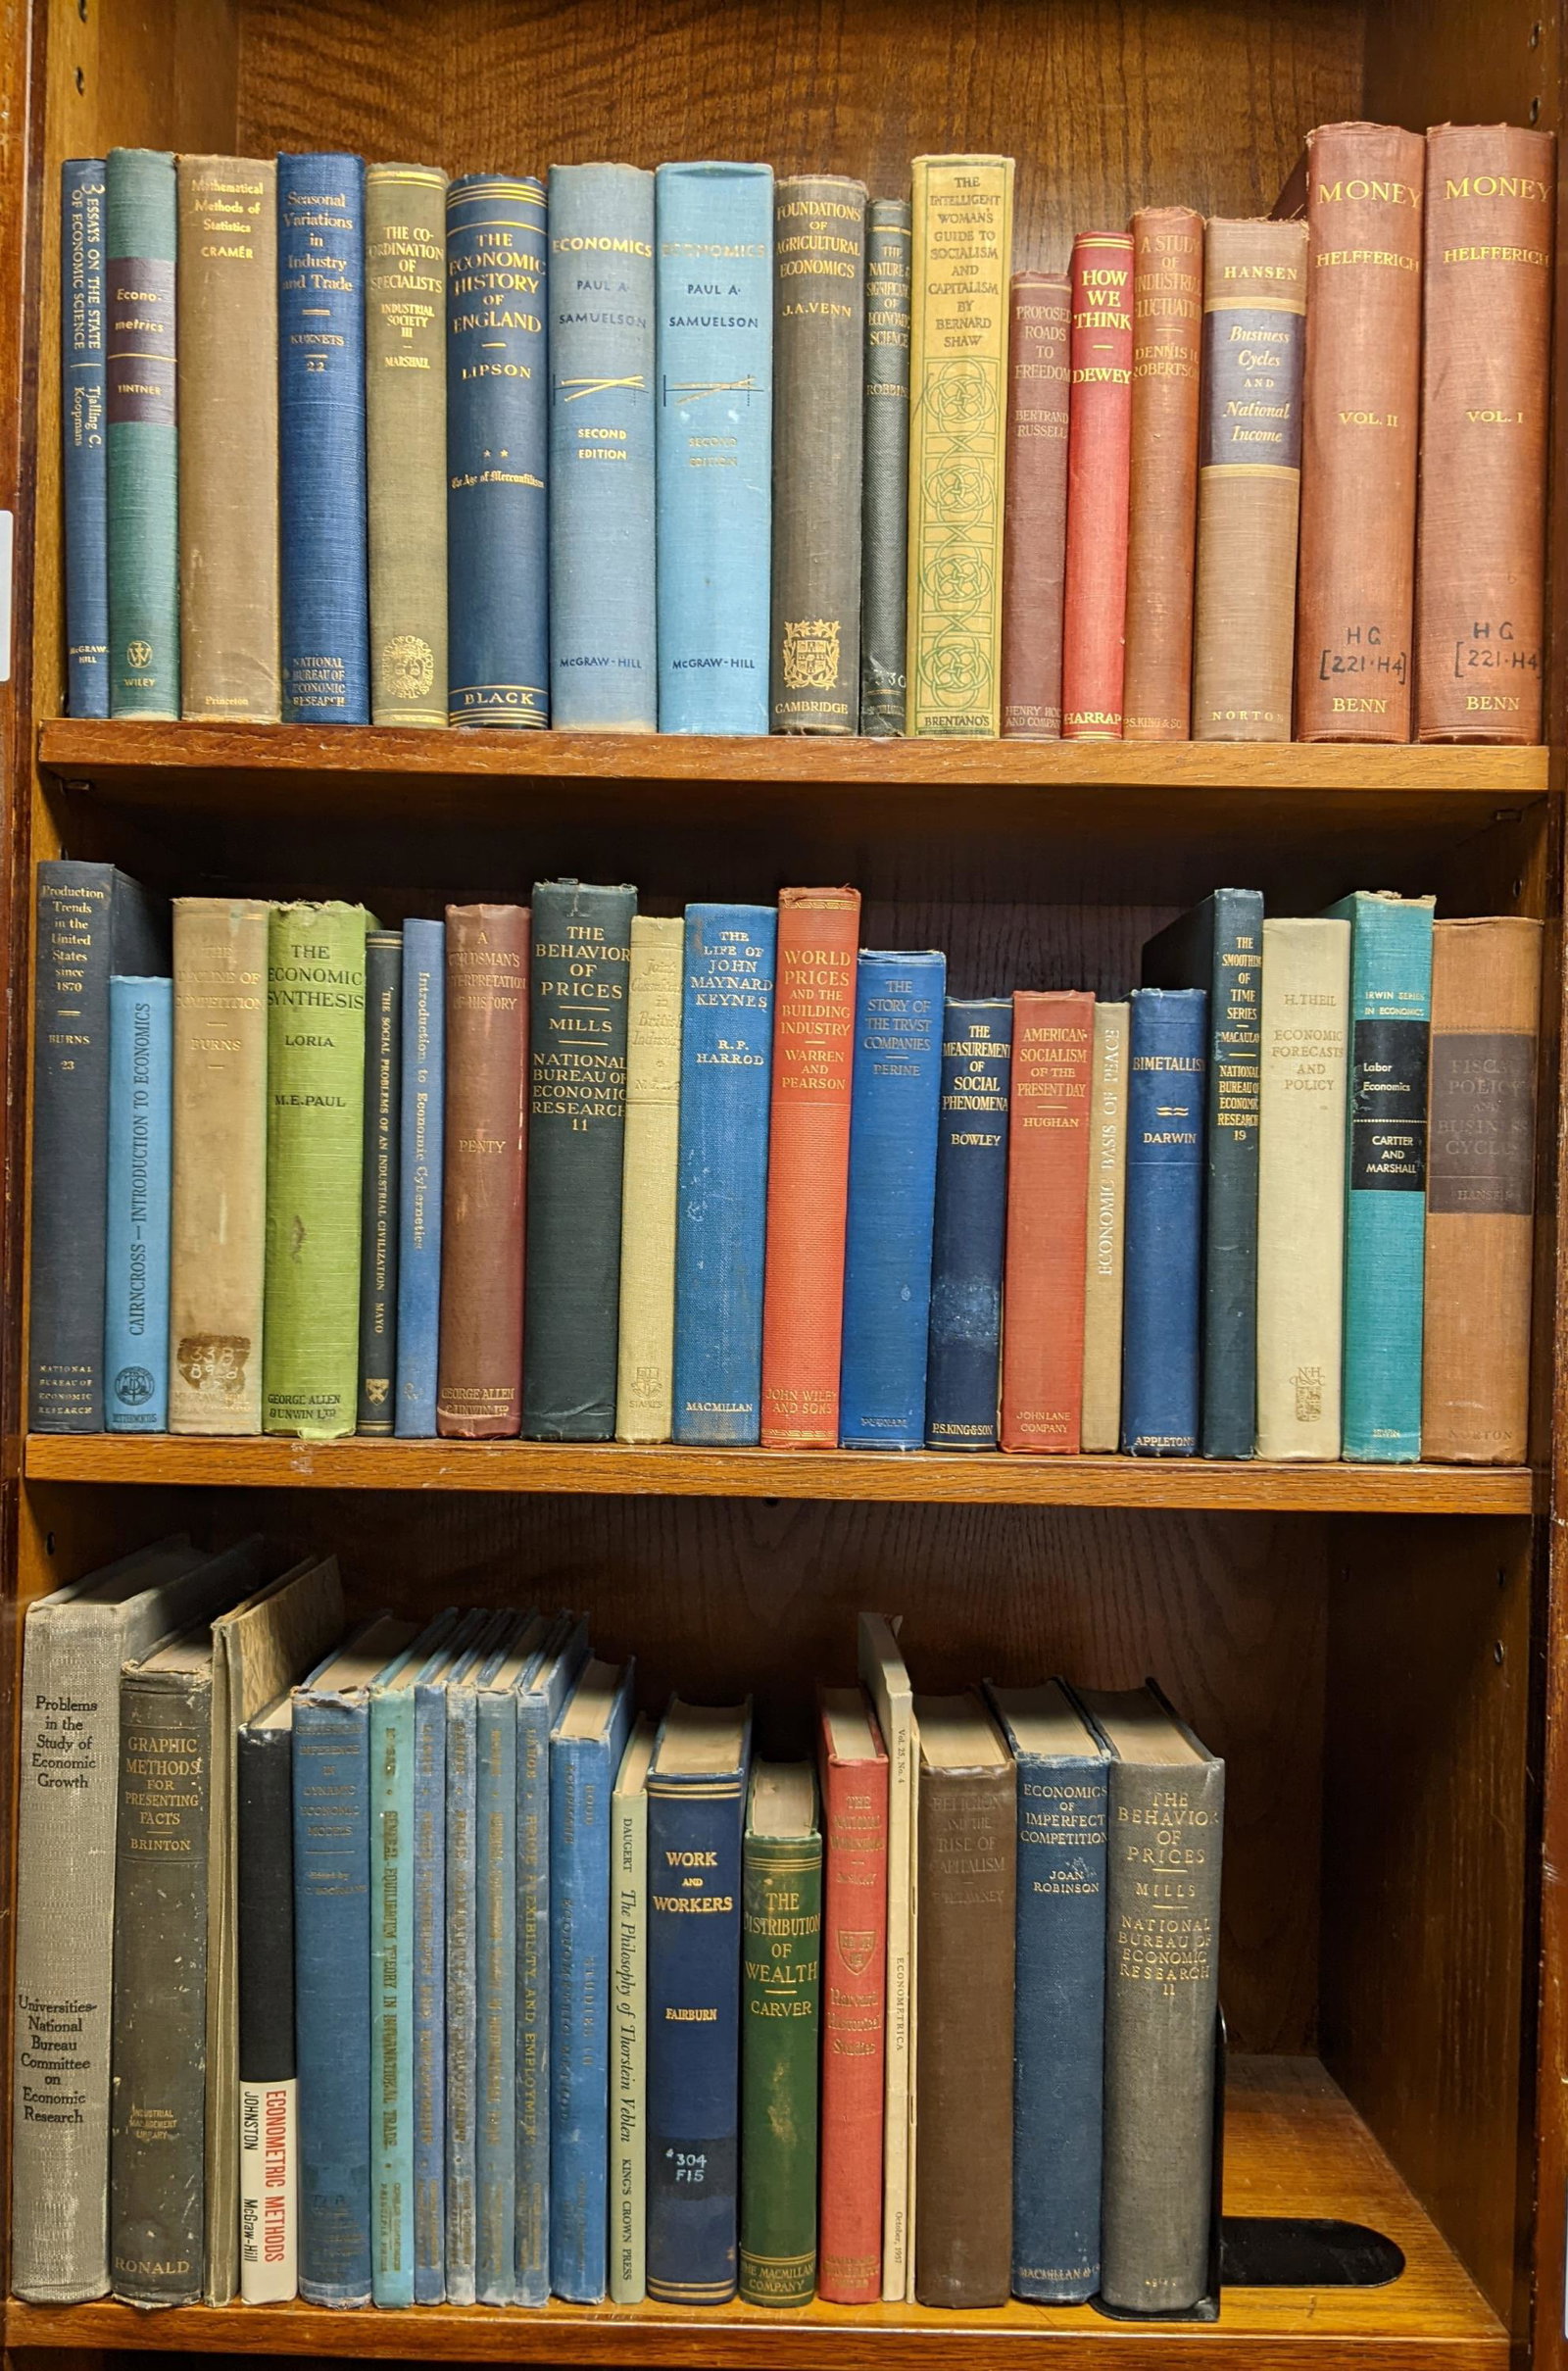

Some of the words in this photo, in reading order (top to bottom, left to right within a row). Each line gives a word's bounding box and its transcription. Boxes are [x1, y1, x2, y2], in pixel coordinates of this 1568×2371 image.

[82, 184, 105, 195] 3
[954, 176, 980, 189] THE
[1444, 175, 1552, 203] MONEY
[72, 189, 82, 208] OF
[1317, 179, 1421, 209] MONEY
[248, 199, 261, 215] of
[88, 199, 100, 243] ESSAYS
[204, 220, 251, 233] Statistics
[809, 222, 828, 230] OF
[309, 232, 323, 247] in
[476, 233, 513, 247] THE
[934, 231, 974, 242] GUIDE
[979, 231, 996, 241] TO
[73, 213, 83, 291] ECONOMIC
[553, 237, 653, 259] ECONOMICS
[930, 249, 999, 260] SOCIALISM
[88, 250, 99, 271] ON
[288, 255, 347, 272] Industry
[449, 252, 546, 276] ECONOMIC
[1315, 250, 1420, 273] HELFFERICH
[1443, 246, 1549, 269] HELFFERICH
[779, 260, 855, 278] ECONOMICS
[952, 266, 979, 276] AND
[1224, 266, 1298, 281] HANSEN
[454, 272, 539, 296] HISTORY
[577, 280, 611, 291] PAUL
[1082, 270, 1128, 286] HOW
[88, 276, 100, 304] THE
[687, 284, 721, 295] PAUL
[928, 282, 999, 295] CAPITALISM
[483, 294, 504, 306] OF
[956, 301, 973, 313] BY
[1088, 291, 1121, 308] WE
[74, 295, 83, 350] SCIENCE
[115, 321, 164, 332] metrics
[453, 311, 542, 334] ENGLAND
[560, 314, 647, 329] SAMUELSON
[668, 317, 759, 328] SAMUELSON
[936, 319, 992, 330] BERNARD
[1074, 313, 1132, 330] THINK
[88, 310, 100, 350] STATE
[1024, 326, 1066, 341] ROADS
[1230, 326, 1290, 343] Business
[944, 336, 981, 348] SHAW
[1036, 346, 1054, 359] TO
[1238, 349, 1281, 370] Cycles
[462, 364, 531, 380] LIPSON
[1073, 368, 1132, 384] DEWEY
[1244, 378, 1275, 387] AND
[1339, 412, 1383, 425] VOL.
[1387, 415, 1398, 427] II
[1466, 411, 1511, 423] VOL.
[1517, 412, 1524, 423] I
[577, 428, 627, 440] SECOND
[1232, 425, 1282, 443] Income
[578, 449, 627, 460] EDITION
[123, 678, 156, 688] WILEY
[464, 692, 534, 705] BLACK
[1332, 697, 1388, 713] BENN
[1465, 696, 1520, 712] BENN
[775, 702, 849, 715] CAMBRIDGE
[53, 902, 92, 914] Trends
[51, 934, 91, 946] United
[565, 926, 605, 941] THE
[53, 950, 88, 962] States
[291, 945, 330, 960] THE
[704, 946, 737, 957] LIFE
[746, 947, 764, 957] OF
[784, 950, 851, 966] WORLD
[55, 967, 84, 978] since
[569, 963, 598, 977] OF
[708, 961, 757, 973] JOHN
[268, 967, 363, 985] ECONOMIC
[785, 970, 850, 987] PRICES
[56, 981, 82, 993] 1870
[541, 982, 622, 999] PRICES
[268, 991, 365, 1011] SYNTHESIS
[695, 993, 767, 1008] KEYNES
[790, 990, 814, 1001] AND
[818, 990, 844, 1001] THE
[1230, 989, 1255, 1003] TIME
[782, 1006, 851, 1018] BUILDING
[867, 1000, 910, 1013] STORY
[912, 1001, 931, 1013] OF
[416, 971, 430, 1063] Introduction
[1227, 1009, 1257, 1021] SERIES
[548, 1018, 612, 1033] MILLS
[781, 1022, 851, 1036] INDUSTRY
[49, 1034, 90, 1045] BURNS
[284, 1036, 335, 1048] LORIA
[381, 1017, 392, 1054] SOCIAL
[134, 1002, 151, 1085] ECONOMICS
[863, 1036, 931, 1052] COMPANIES
[696, 1054, 764, 1065] HARROD
[1020, 1048, 1087, 1063] SOCIALISM
[1103, 1029, 1120, 1082] PEACE
[61, 1061, 75, 1070] 23
[969, 1061, 985, 1072] OF
[1030, 1067, 1048, 1077] OF
[1051, 1067, 1076, 1078] THE
[1363, 1062, 1393, 1073] Labor
[417, 1068, 427, 1082] to
[533, 1070, 607, 1084] BUREAU
[380, 1059, 390, 1113] PROBLEMS
[782, 1077, 846, 1090] PEARSON
[954, 1077, 1001, 1092] SOCIAL
[1284, 1080, 1335, 1091] POLICY
[1363, 1081, 1411, 1092] Economics
[134, 1089, 148, 1112] TO
[1104, 1092, 1117, 1115] OF
[416, 1092, 428, 1160] Economic
[1023, 1117, 1079, 1127] HUGHAN
[951, 1133, 1002, 1146] BOWLEY
[1143, 1133, 1197, 1144] DARWIN
[1233, 1130, 1247, 1141] 19
[1372, 1136, 1413, 1146] CARTTER
[459, 1139, 507, 1154] PENTY
[1101, 1125, 1116, 1169] BASIS
[131, 1119, 148, 1223] INTRODUCTION
[1365, 1163, 1417, 1174] MARSHALL
[376, 1220, 387, 1291] CIVILIZATION
[129, 1243, 146, 1337] CAIRNCROSS
[375, 1303, 385, 1334] MAYO
[686, 1402, 753, 1412] MACMILLAN
[35, 1696, 98, 1711] Problems
[45, 1716, 58, 1731] in
[63, 1717, 83, 1731] the
[36, 1735, 74, 1751] Study
[78, 1736, 93, 1750] of
[128, 1737, 197, 1754] GRAPHIC
[31, 1754, 96, 1769] Economic
[37, 1773, 89, 1788] Growth
[125, 1792, 199, 1806] PRESENTING
[1023, 1784, 1107, 1799] ECONOMICS
[1026, 1813, 1105, 1827] IMPERFECT
[130, 1839, 191, 1851] BRINTON
[622, 1818, 632, 1873] DAUGERT
[665, 1852, 718, 1866] WORK
[1127, 1847, 1205, 1863] PRICES
[1033, 1882, 1100, 1894] ROBINSON
[1136, 1883, 1196, 1897] MILLS
[653, 1896, 733, 1913] WORKERS
[771, 1943, 792, 1957] OF
[1123, 1949, 1207, 1965] ECONOMIC
[615, 1922, 636, 1998] Philosophy
[745, 1961, 817, 1983] WEALTH
[750, 2001, 811, 2016] CARVER
[896, 1956, 906, 2052] ECONOMETRICA
[665, 2007, 717, 2020] FAIRBURN
[27, 2015, 82, 2033] National
[21, 2053, 91, 2070] Committee
[23, 2105, 83, 2124] Research
[244, 2091, 260, 2150] JOHNSTON
[620, 2098, 635, 2143] Veblen
[265, 2091, 286, 2189] ECONOMETRIC
[676, 2153, 708, 2168] 304
[675, 2169, 705, 2183] F15
[264, 2196, 285, 2263] METHODS
[621, 2200, 632, 2244] CROWN
[244, 2198, 259, 2262] McGraw-Hill
[115, 2257, 190, 2276] RONALD
[622, 2248, 632, 2281] PRESS
